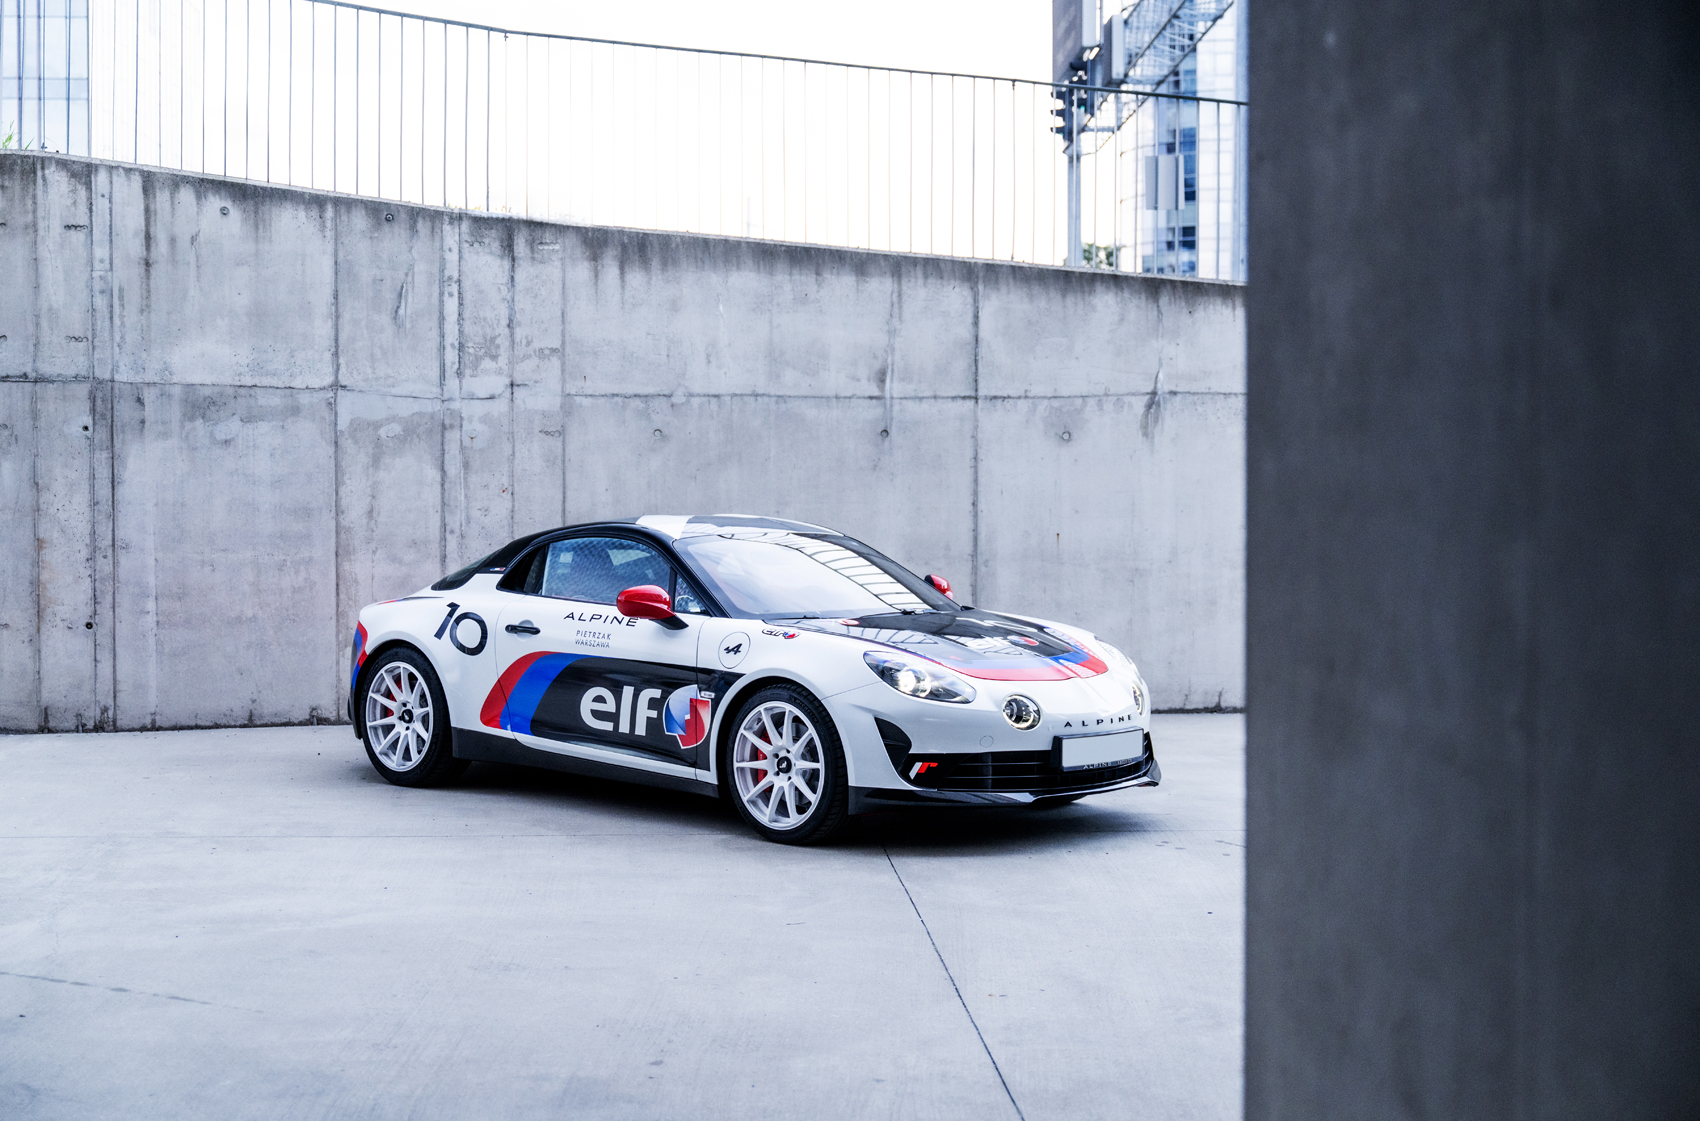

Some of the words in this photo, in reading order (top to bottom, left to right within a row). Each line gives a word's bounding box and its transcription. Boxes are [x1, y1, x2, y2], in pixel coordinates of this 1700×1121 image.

[563, 612, 639, 627] ALPINE
[434, 602, 488, 656] 10
[576, 630, 612, 640] PIETRZAK
[575, 638, 611, 648] WARSZAWA
[580, 685, 662, 736] elf
[1063, 714, 1132, 728] ALPINE
[1083, 761, 1112, 770] ALPINE
